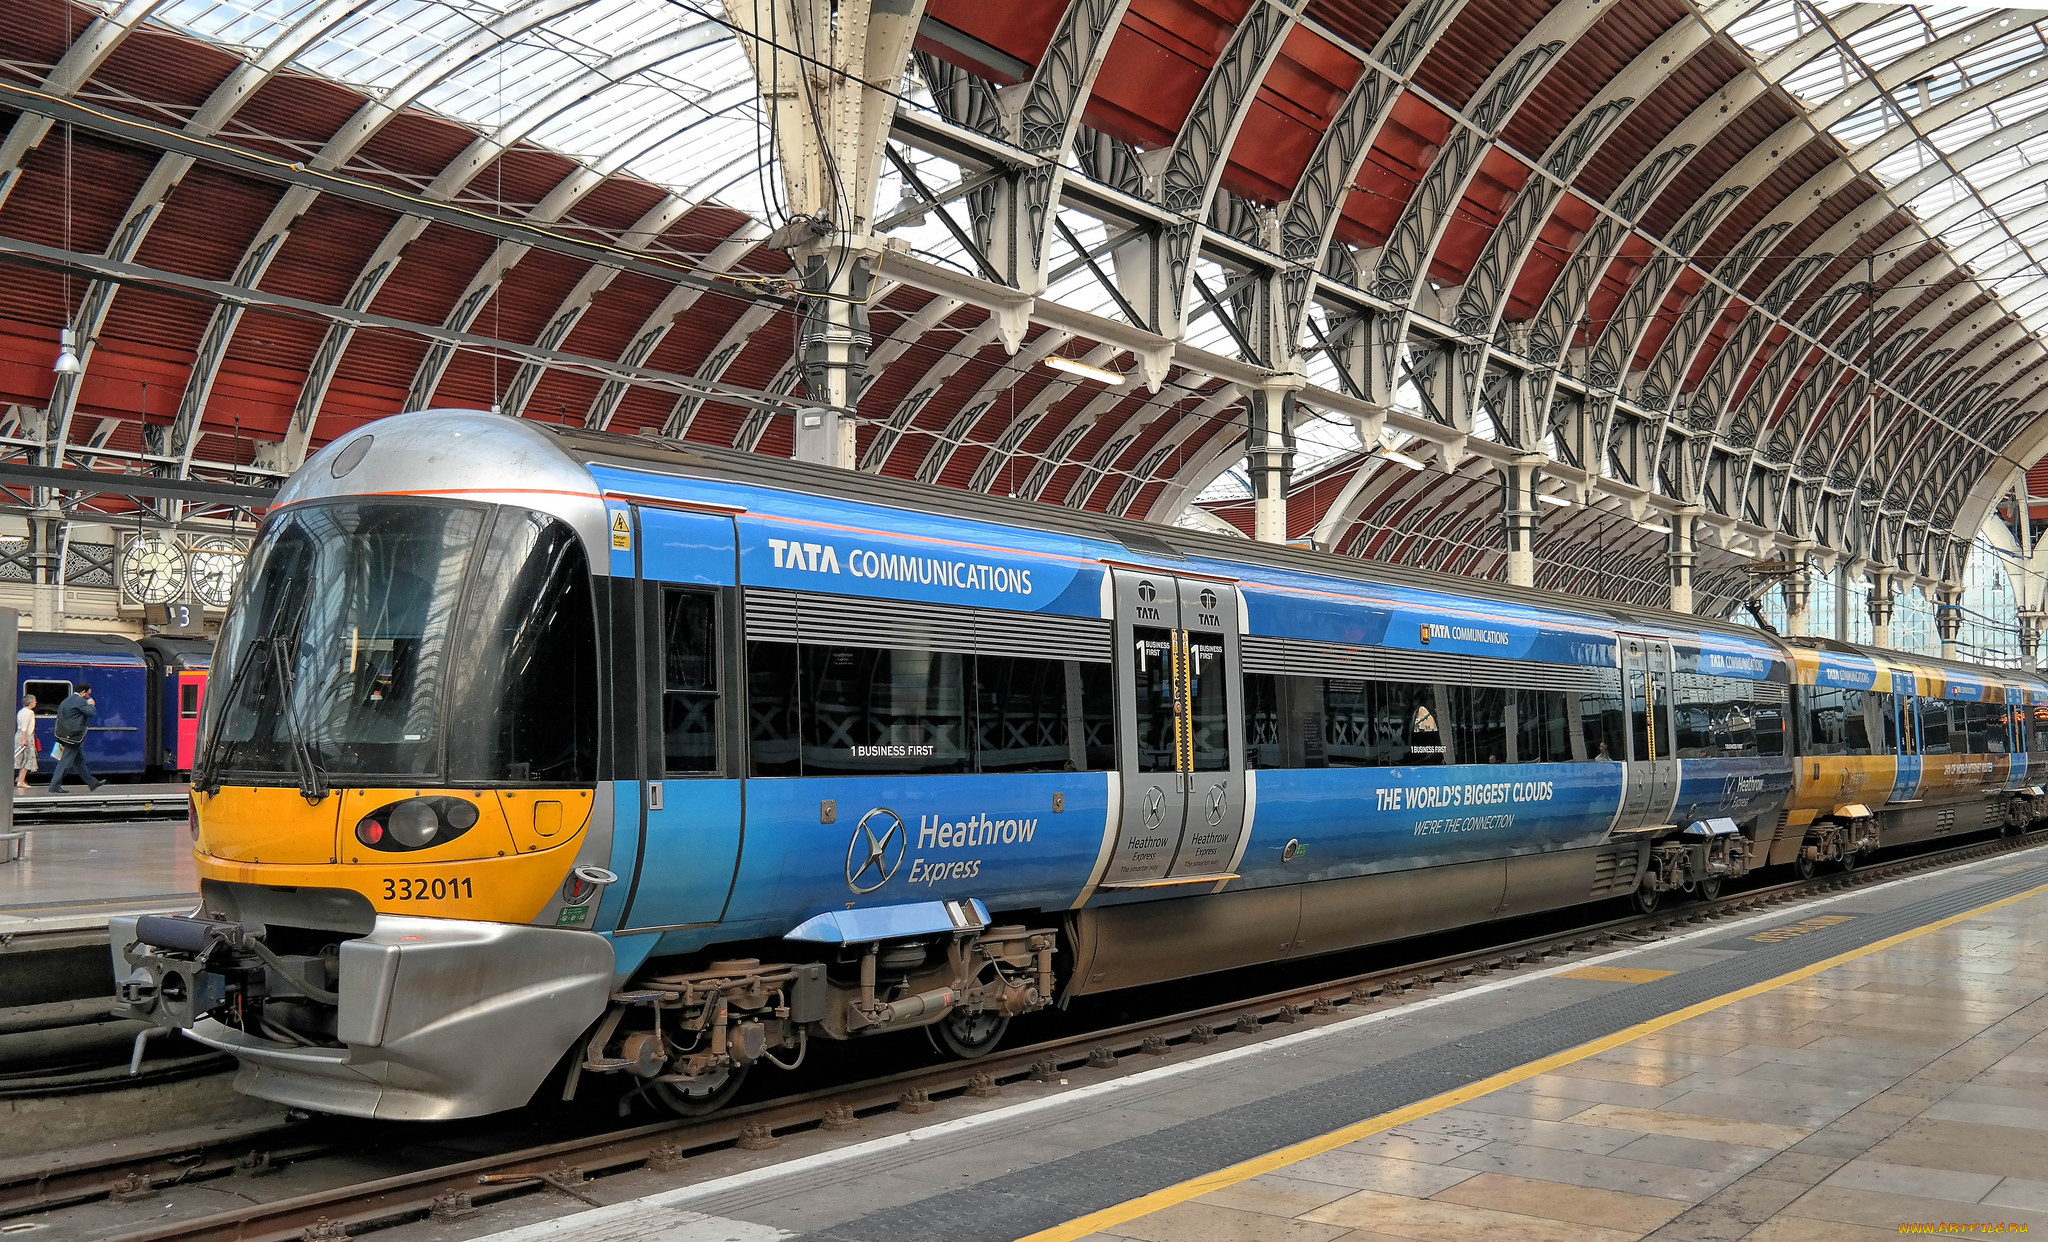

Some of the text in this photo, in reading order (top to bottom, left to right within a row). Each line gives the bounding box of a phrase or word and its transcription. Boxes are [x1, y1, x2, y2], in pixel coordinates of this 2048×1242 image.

[768, 538, 1032, 595] TATA COMMUNICATIONS
[180, 605, 190, 628] 3
[1136, 606, 1160, 620] TATA
[1198, 613, 1221, 626] TATA
[1429, 623, 1509, 645] TATA COMMUNICATIONS
[1145, 641, 1170, 650] BUSINESS
[1146, 648, 1160, 656] FIRST
[1199, 645, 1222, 653] BUSINESS
[1135, 640, 1146, 672] 1
[1190, 644, 1200, 675] 1
[1200, 652, 1213, 660] FIRST
[1709, 654, 1764, 672] TATA COMMUNICATIONS
[851, 745, 934, 756] 1 BUSINESS FIRST
[1413, 745, 1434, 753] BUSINESS
[1435, 745, 1446, 753] FIRST
[1376, 781, 1553, 811] THE WORLD'S BIGGEST CLOUDS
[917, 812, 1038, 849] Heathrow
[1413, 814, 1515, 836] WE'RE THE CONNECTION
[1127, 835, 1169, 850] Heathrow
[1191, 831, 1229, 845] Heathrow
[1132, 851, 1156, 863] Express
[1195, 847, 1217, 858] Express
[1149, 864, 1159, 872] way
[1192, 860, 1210, 868] smarter
[1210, 859, 1220, 867] way
[908, 858, 982, 887] Express
[382, 877, 473, 901] 332011
